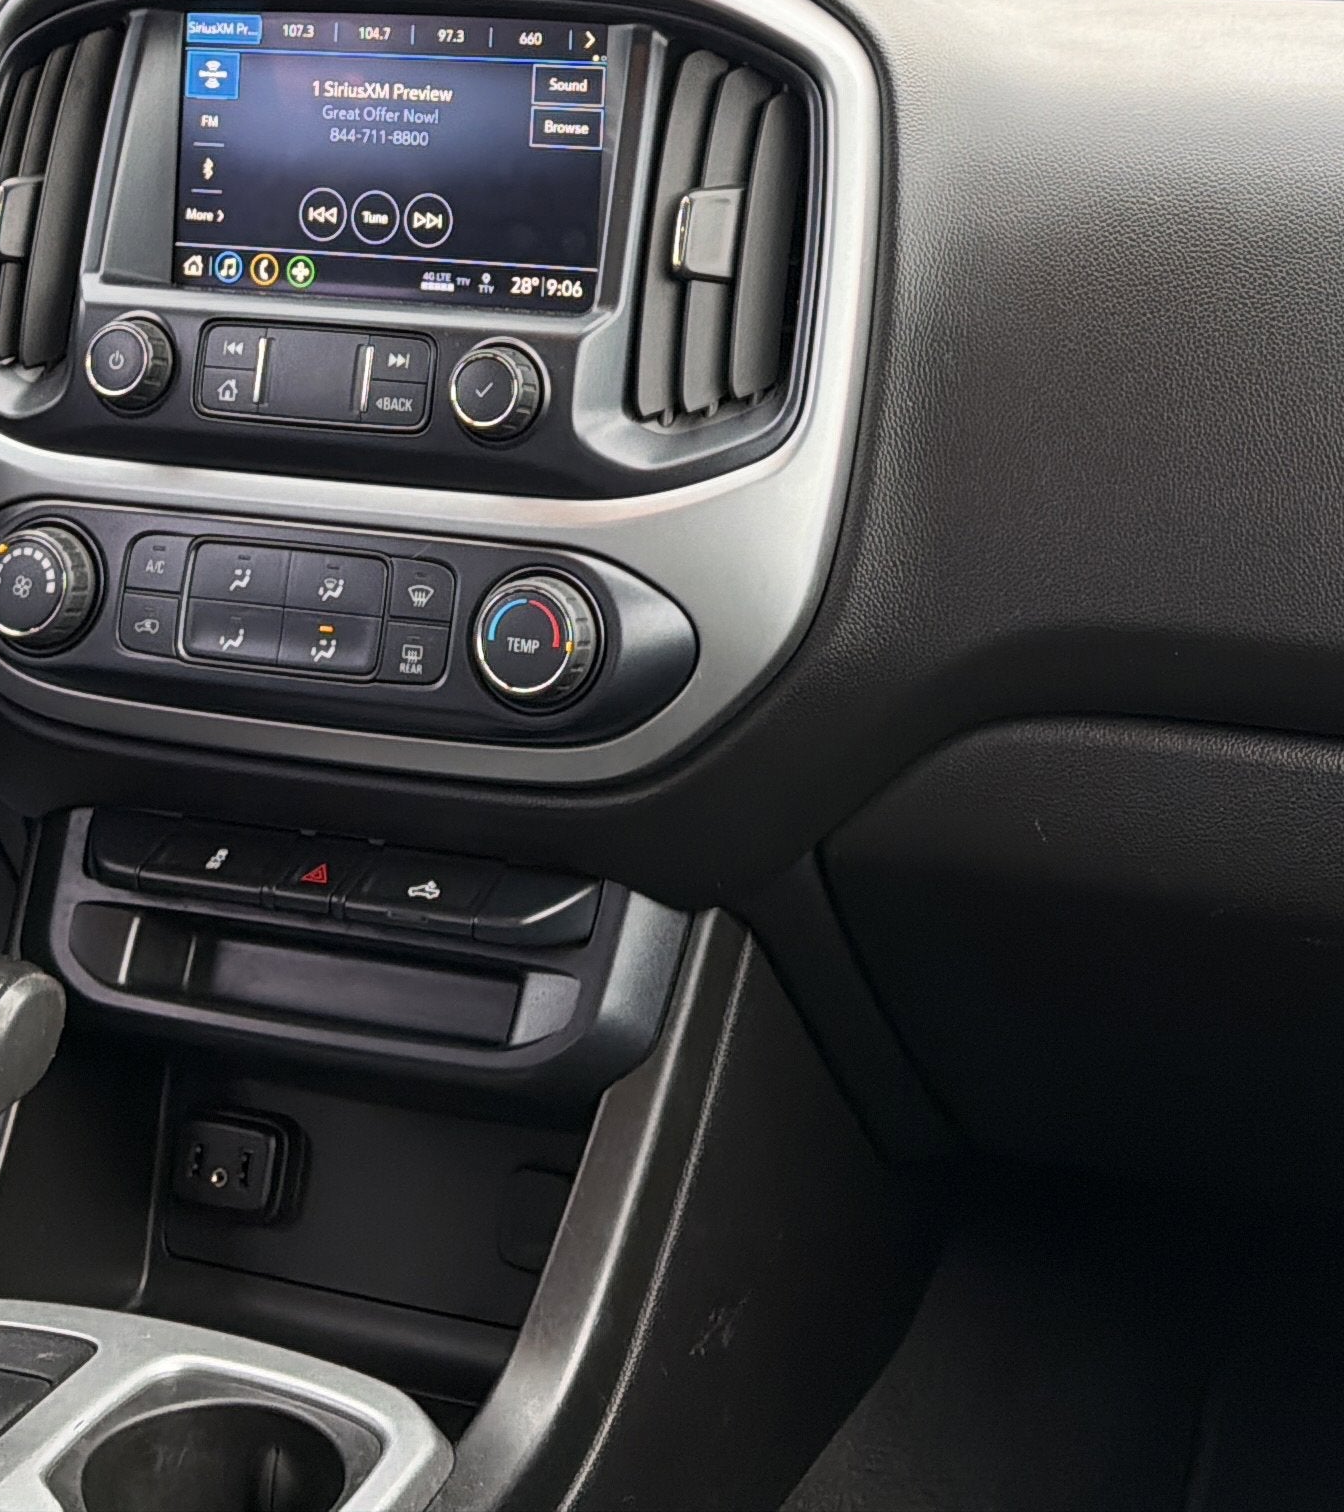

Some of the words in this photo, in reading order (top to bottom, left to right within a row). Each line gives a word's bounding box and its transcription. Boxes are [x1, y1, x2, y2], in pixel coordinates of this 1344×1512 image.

[188, 21, 233, 35] SiriusXM
[282, 23, 315, 38] 107.3
[358, 26, 391, 41] 104.7
[437, 29, 465, 43] 97.3
[519, 32, 543, 46] 660
[312, 80, 321, 97] 1
[323, 80, 388, 100] SiriusXM
[392, 84, 453, 102] Preview
[549, 77, 588, 93] Sound
[201, 114, 219, 128] FM
[322, 104, 361, 121] Great
[363, 106, 399, 123] Offer
[403, 108, 439, 124] Now!
[544, 119, 590, 135] Browse
[329, 127, 429, 147] 844-711-8800
[185, 208, 214, 221] More
[361, 210, 389, 225] Tune
[436, 272, 453, 282] LTE
[510, 276, 540, 295] 28°
[546, 279, 584, 298] 9:06
[382, 397, 413, 414] BACK
[145, 559, 166, 574] A/C
[507, 636, 541, 655] TEMP
[399, 661, 424, 675] REAR
